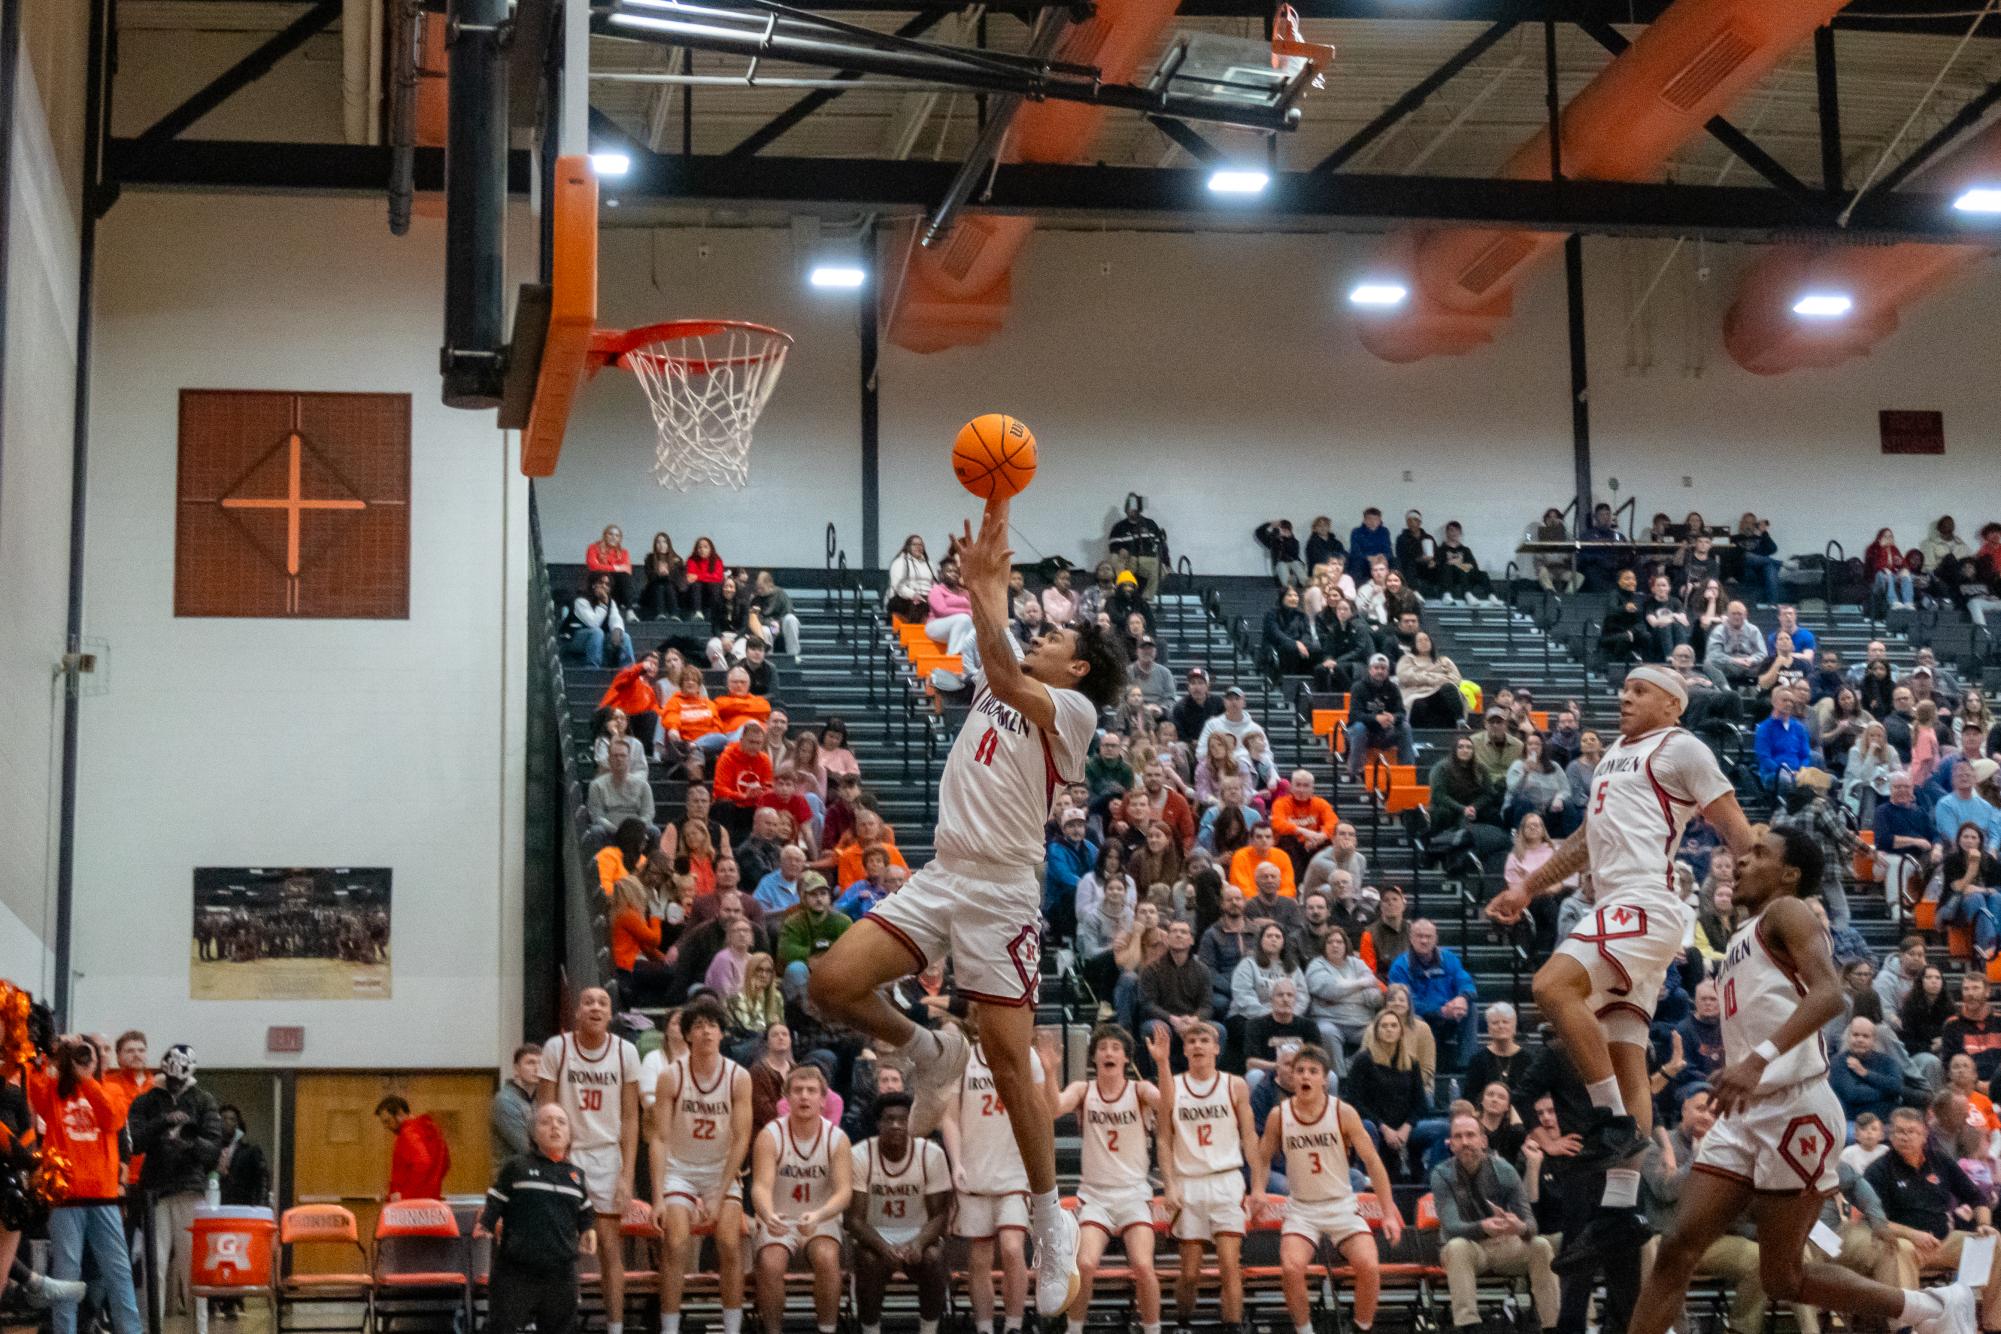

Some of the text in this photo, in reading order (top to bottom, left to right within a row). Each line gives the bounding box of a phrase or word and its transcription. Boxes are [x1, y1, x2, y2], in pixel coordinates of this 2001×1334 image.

[974, 726, 998, 767] 11
[1594, 781, 1609, 815] 5
[1611, 907, 1633, 926] N
[1724, 976, 1737, 1020] 10
[968, 1077, 995, 1090] IRON
[579, 1088, 602, 1112] 30
[982, 1094, 1005, 1116] 24
[1088, 1109, 1137, 1125] IRONMEN
[1179, 1104, 1229, 1121] IRONMEN
[693, 1119, 716, 1139] 22
[1197, 1124, 1213, 1146] 12
[1107, 1130, 1119, 1152] 2
[1286, 1132, 1338, 1150] IRONMEN
[1799, 1136, 1817, 1157] N
[1309, 1152, 1322, 1174] 3
[792, 1183, 810, 1203] 41
[882, 1200, 905, 1218] 43
[217, 1233, 238, 1255] G
